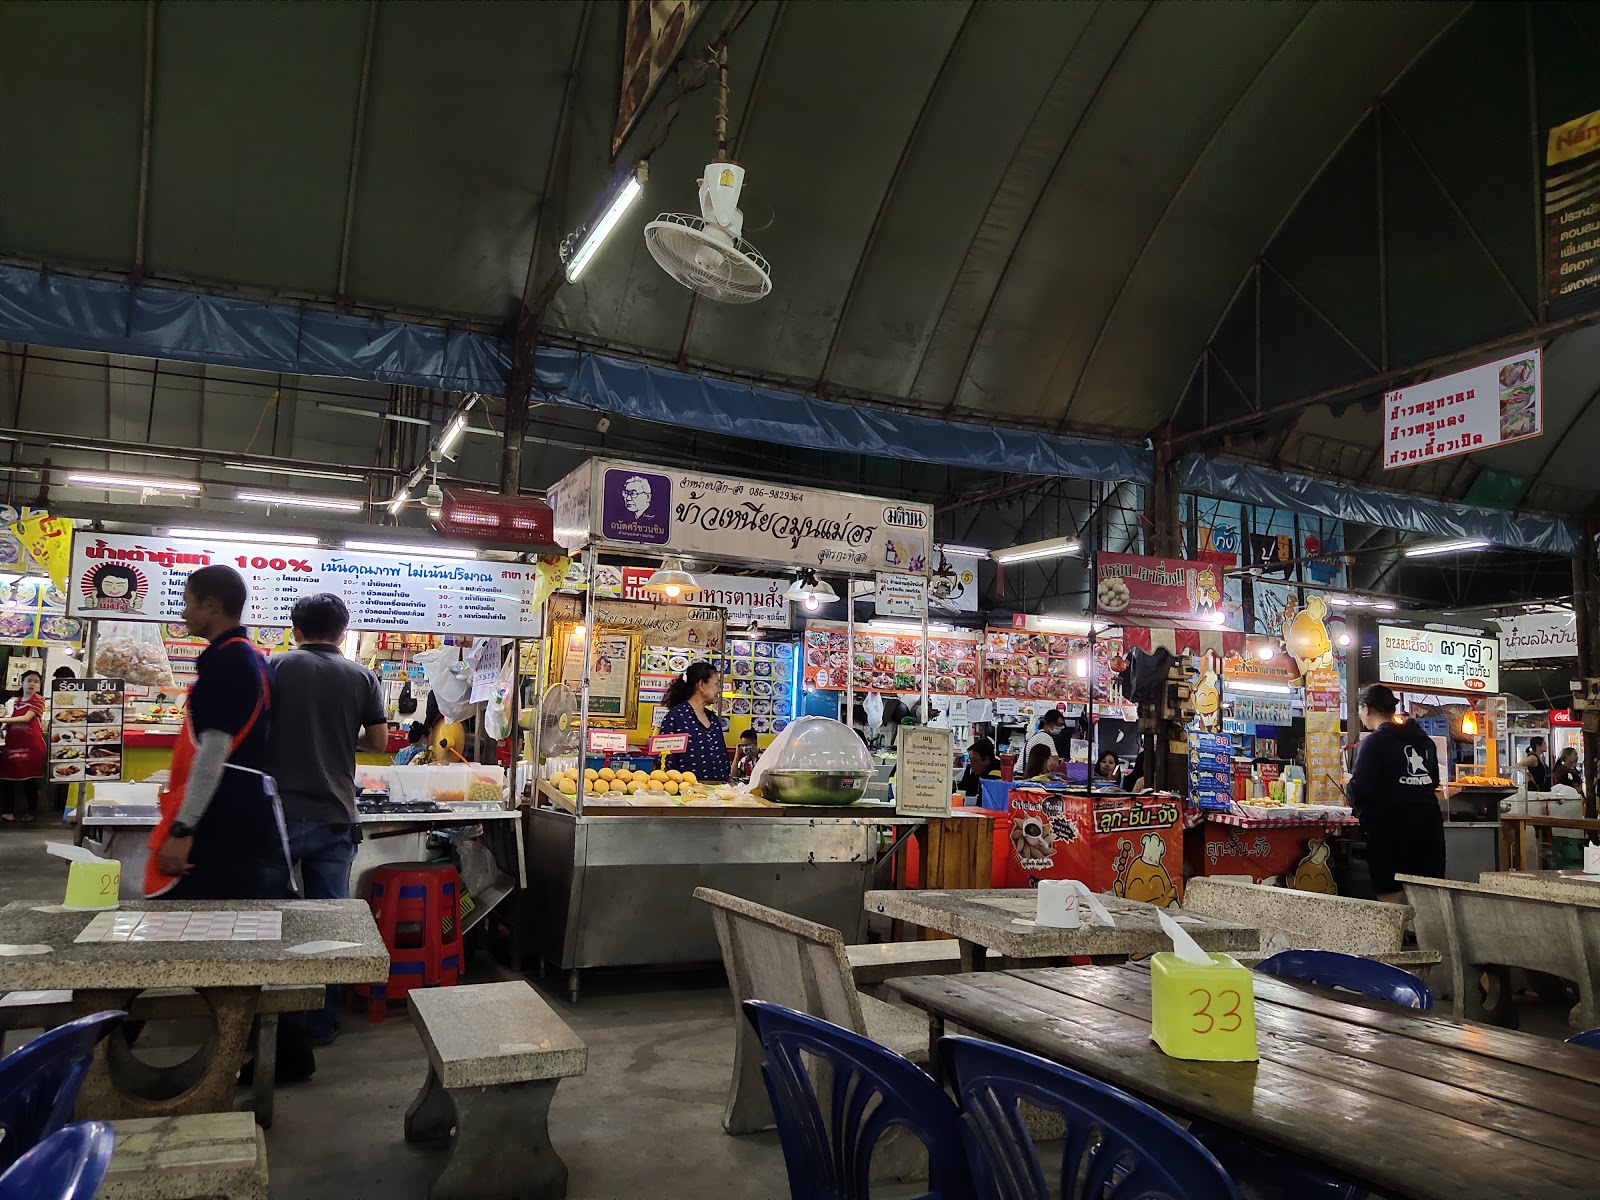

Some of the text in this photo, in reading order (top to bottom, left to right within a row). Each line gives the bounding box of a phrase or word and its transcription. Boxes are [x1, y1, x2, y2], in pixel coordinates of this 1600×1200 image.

[1391, 389, 1475, 421] ข้าวหมูกรอบ
[1390, 413, 1465, 441] ข้าวหมูแดง
[749, 487, 804, 503] 086-9829364
[676, 491, 878, 550] ข้าวเหนียวมูนแม่อร
[887, 506, 924, 527] มติชน
[610, 520, 665, 535] ถนัดศรีชวนชิม
[85, 539, 215, 568] น้ำเต้าหู้แท้
[235, 555, 313, 573] 100%
[321, 557, 401, 579] เน้นคุณภาพ
[400, 562, 493, 583] ไม่เน้นปริมาณ
[501, 570, 521, 580] สาขา
[1428, 665, 1442, 673] จาก
[59, 680, 117, 691] ร้อน เย็น
[1216, 735, 1229, 746] 30
[1216, 754, 1228, 765] 40
[1100, 802, 1179, 833] ลูก-ชิ้น-จัง
[1189, 988, 1242, 1034] 33
